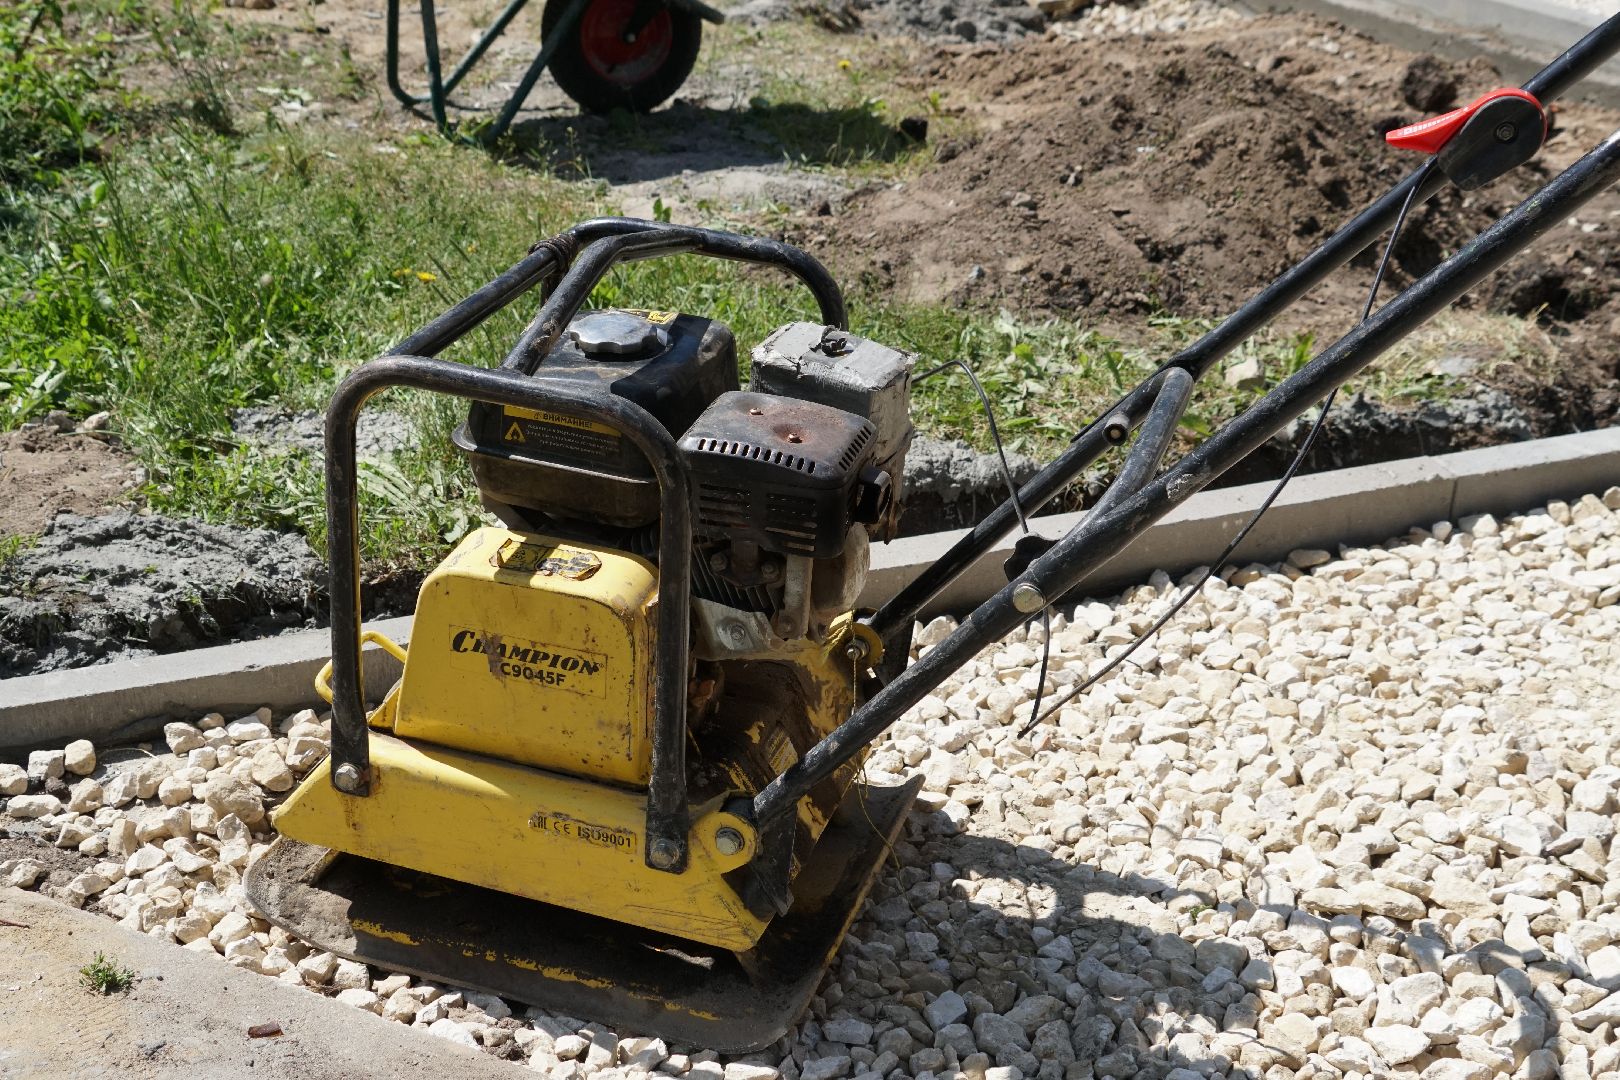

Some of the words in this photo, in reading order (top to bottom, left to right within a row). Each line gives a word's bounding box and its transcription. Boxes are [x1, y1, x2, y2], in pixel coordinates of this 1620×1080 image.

[543, 413, 593, 429] ВНИМАНИЕ!
[489, 660, 567, 686] C9045F
[577, 825, 631, 848] ISO9001
